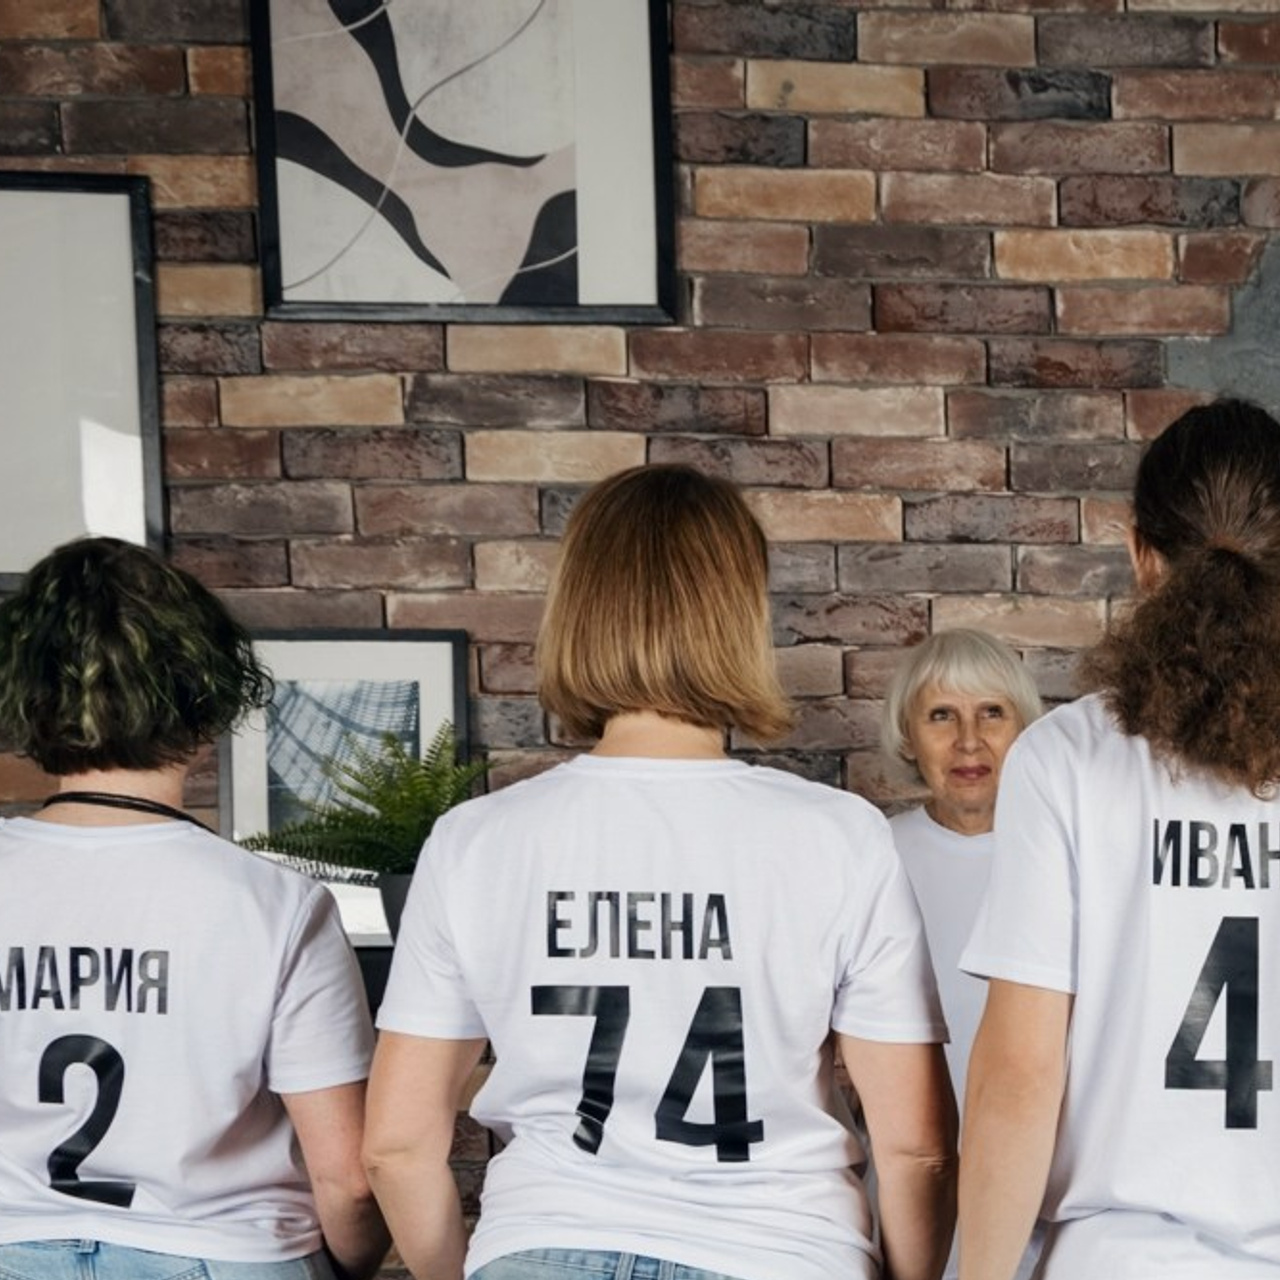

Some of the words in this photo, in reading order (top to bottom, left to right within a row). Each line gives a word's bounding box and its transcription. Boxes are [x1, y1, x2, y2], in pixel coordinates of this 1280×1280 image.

[0, 946, 169, 1015] МАРИЯ
[547, 891, 733, 960] ЕЛЕНА
[531, 985, 764, 1163] 74
[1164, 916, 1273, 1129] 4
[38, 1034, 137, 1209] 2
